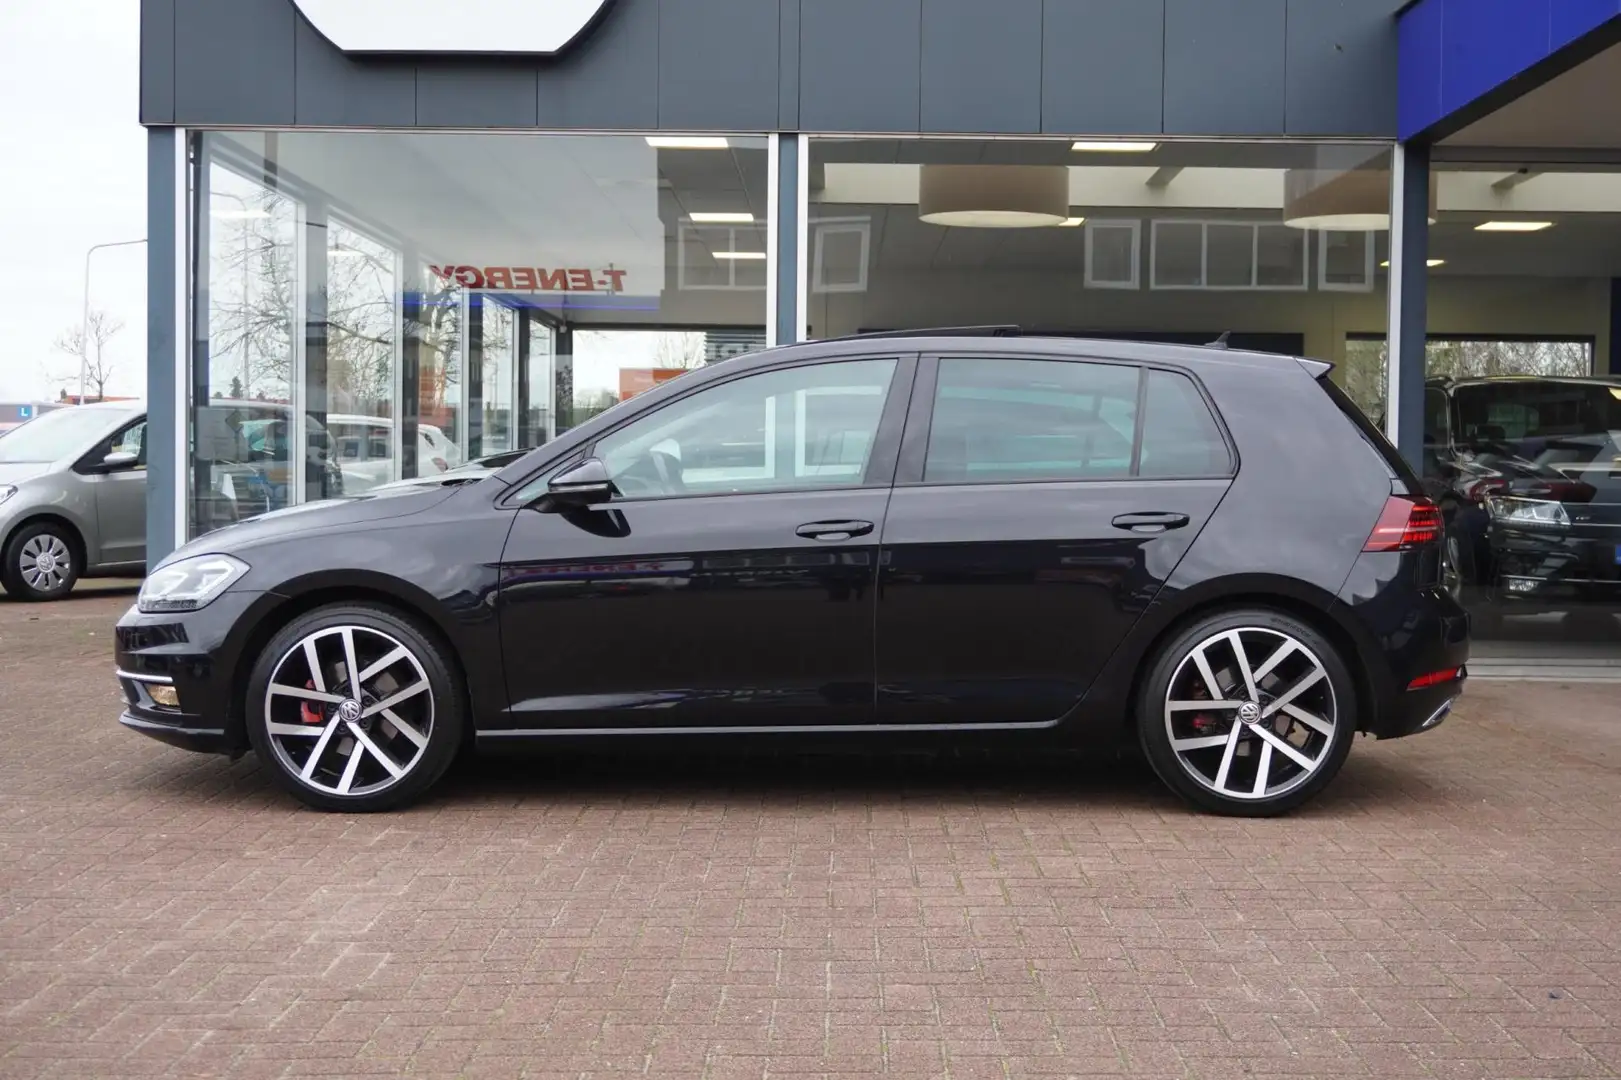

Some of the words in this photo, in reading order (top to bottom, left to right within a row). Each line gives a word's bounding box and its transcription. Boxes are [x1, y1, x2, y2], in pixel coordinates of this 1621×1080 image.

[20, 407, 29, 417] L
[340, 700, 361, 721] VW
[1239, 702, 1260, 723] VW
